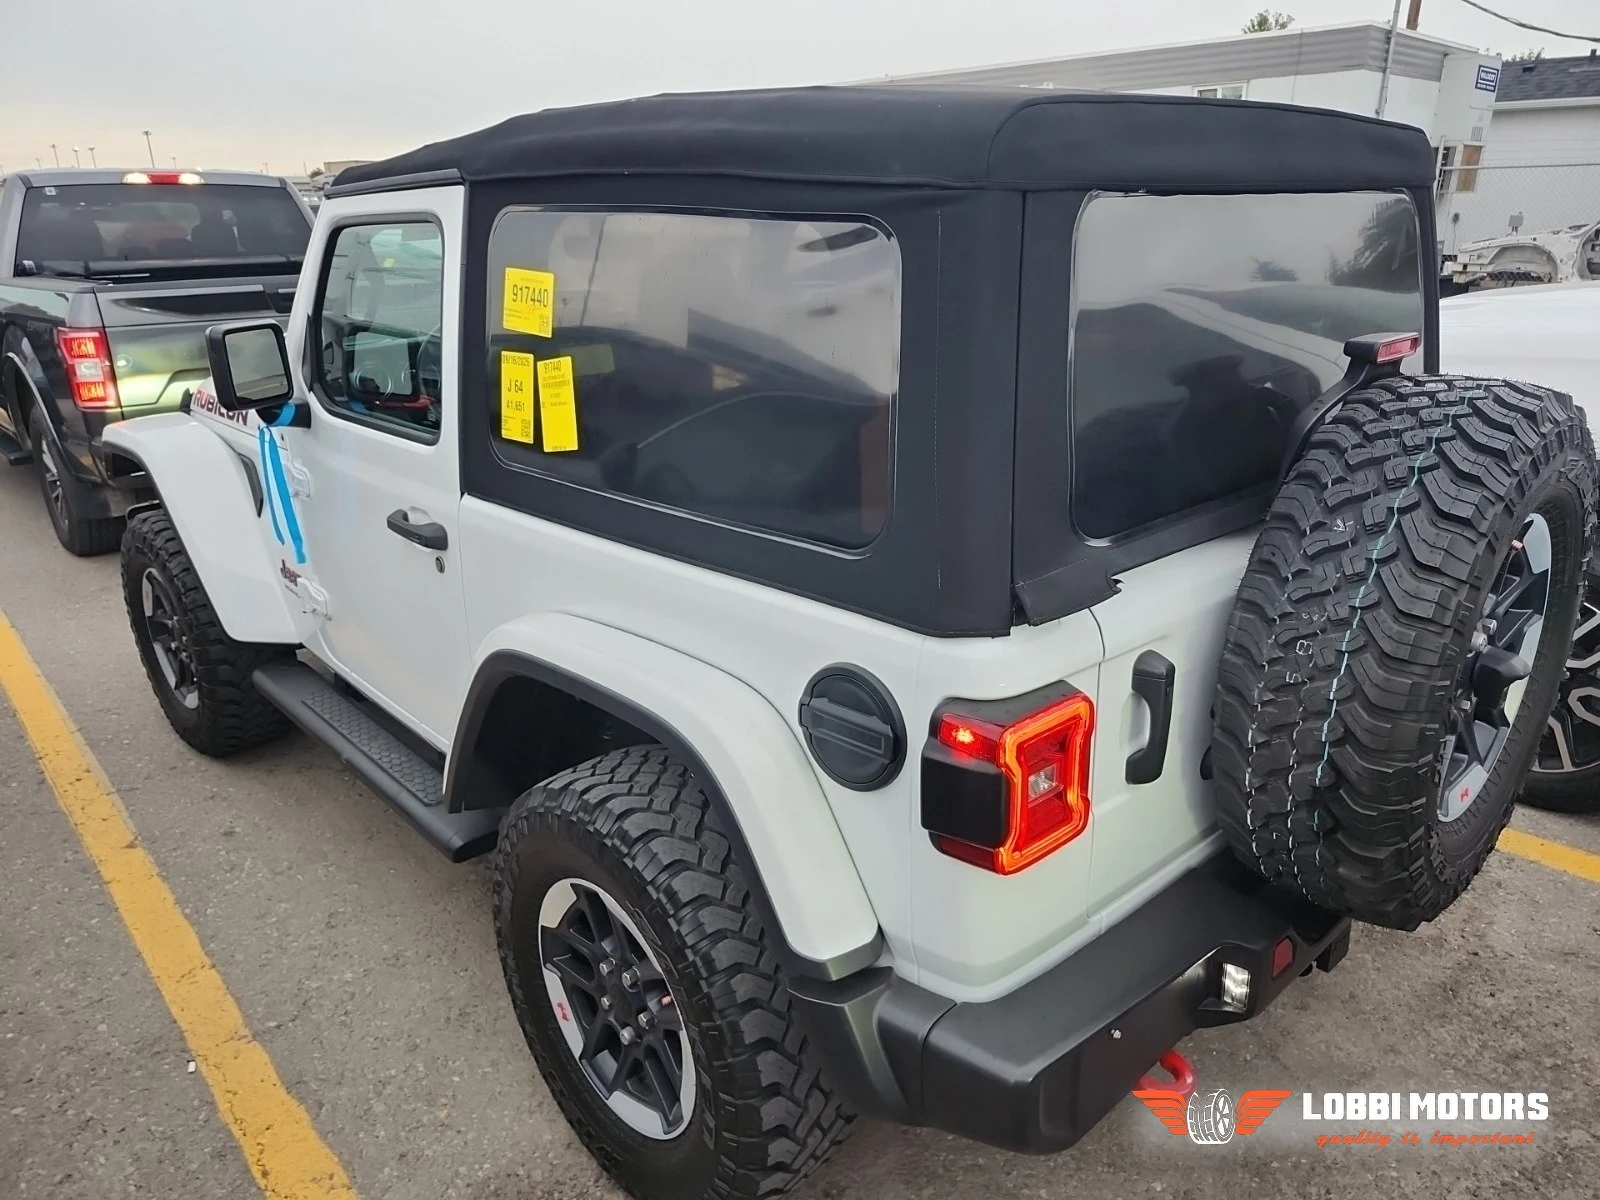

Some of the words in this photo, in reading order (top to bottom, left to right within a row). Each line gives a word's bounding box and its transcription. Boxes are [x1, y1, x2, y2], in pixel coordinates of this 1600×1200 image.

[512, 284, 549, 308] 917440
[507, 378, 512, 392] J
[514, 379, 524, 394] 64
